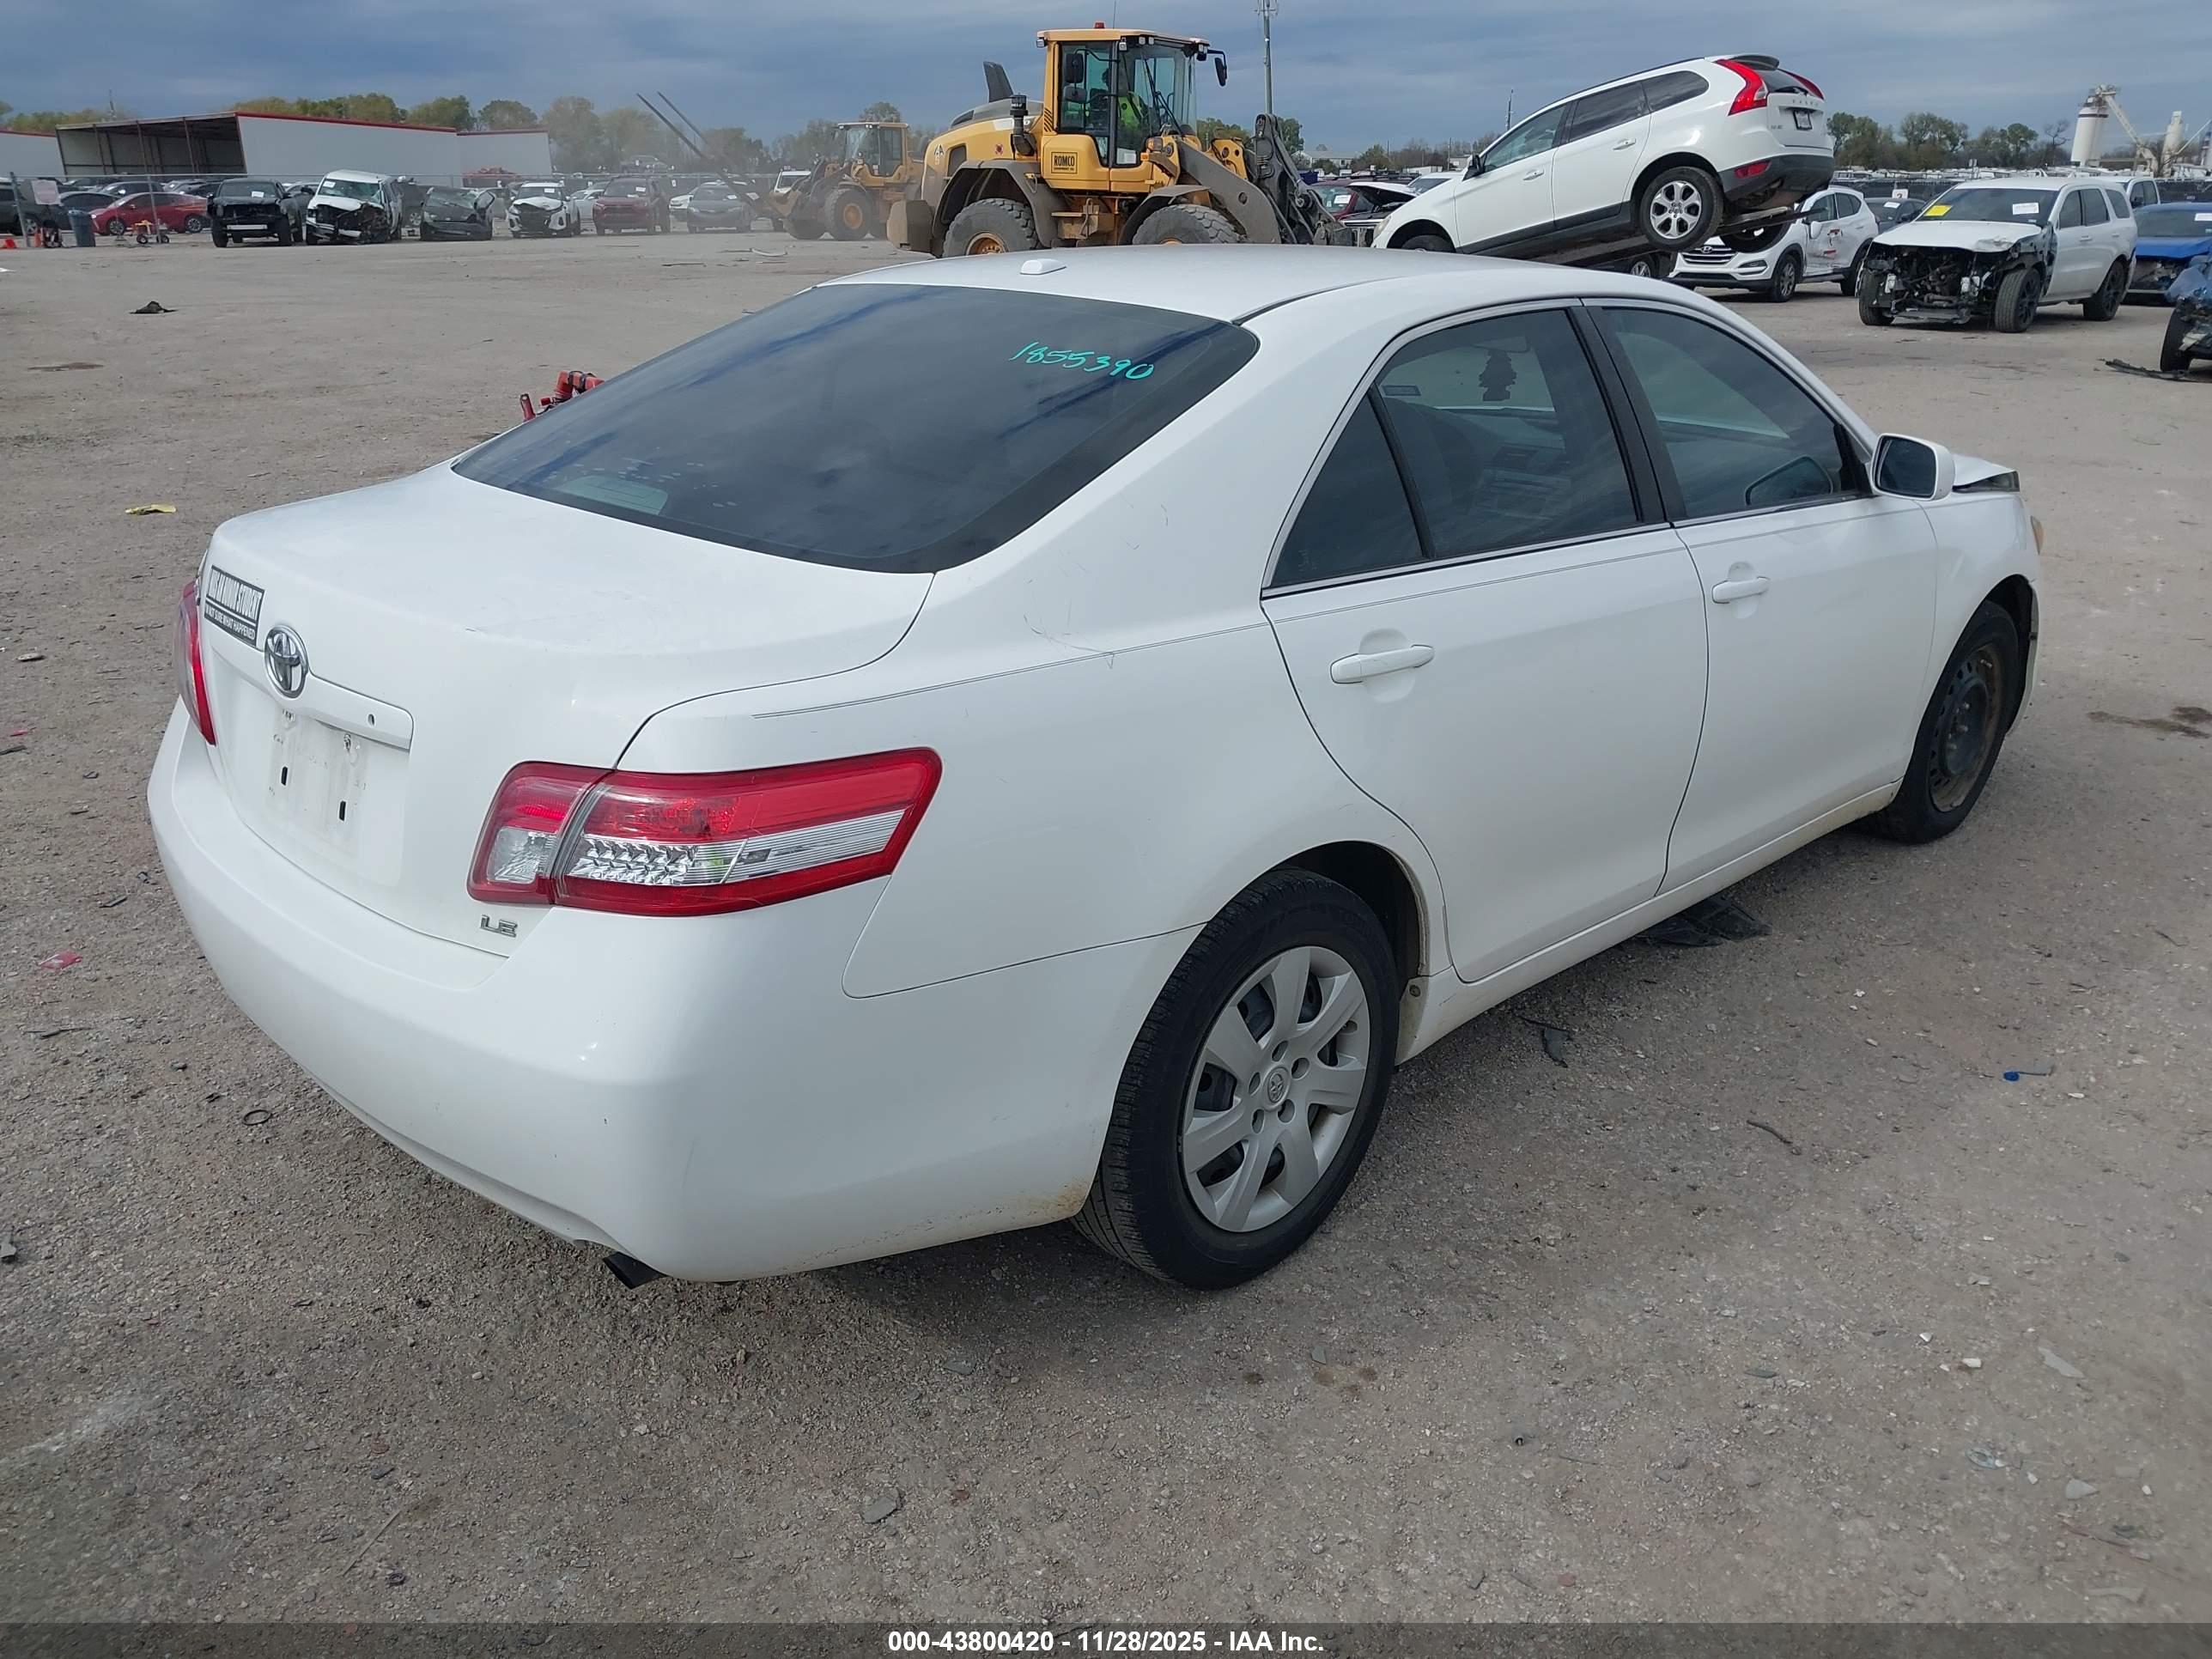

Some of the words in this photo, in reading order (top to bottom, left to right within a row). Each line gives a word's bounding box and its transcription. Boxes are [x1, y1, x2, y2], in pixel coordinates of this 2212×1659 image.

[1054, 155, 1075, 167] ROMCO
[236, 584, 263, 620] STUDENT
[234, 619, 256, 641] HAPPENED
[480, 915, 518, 938] LE
